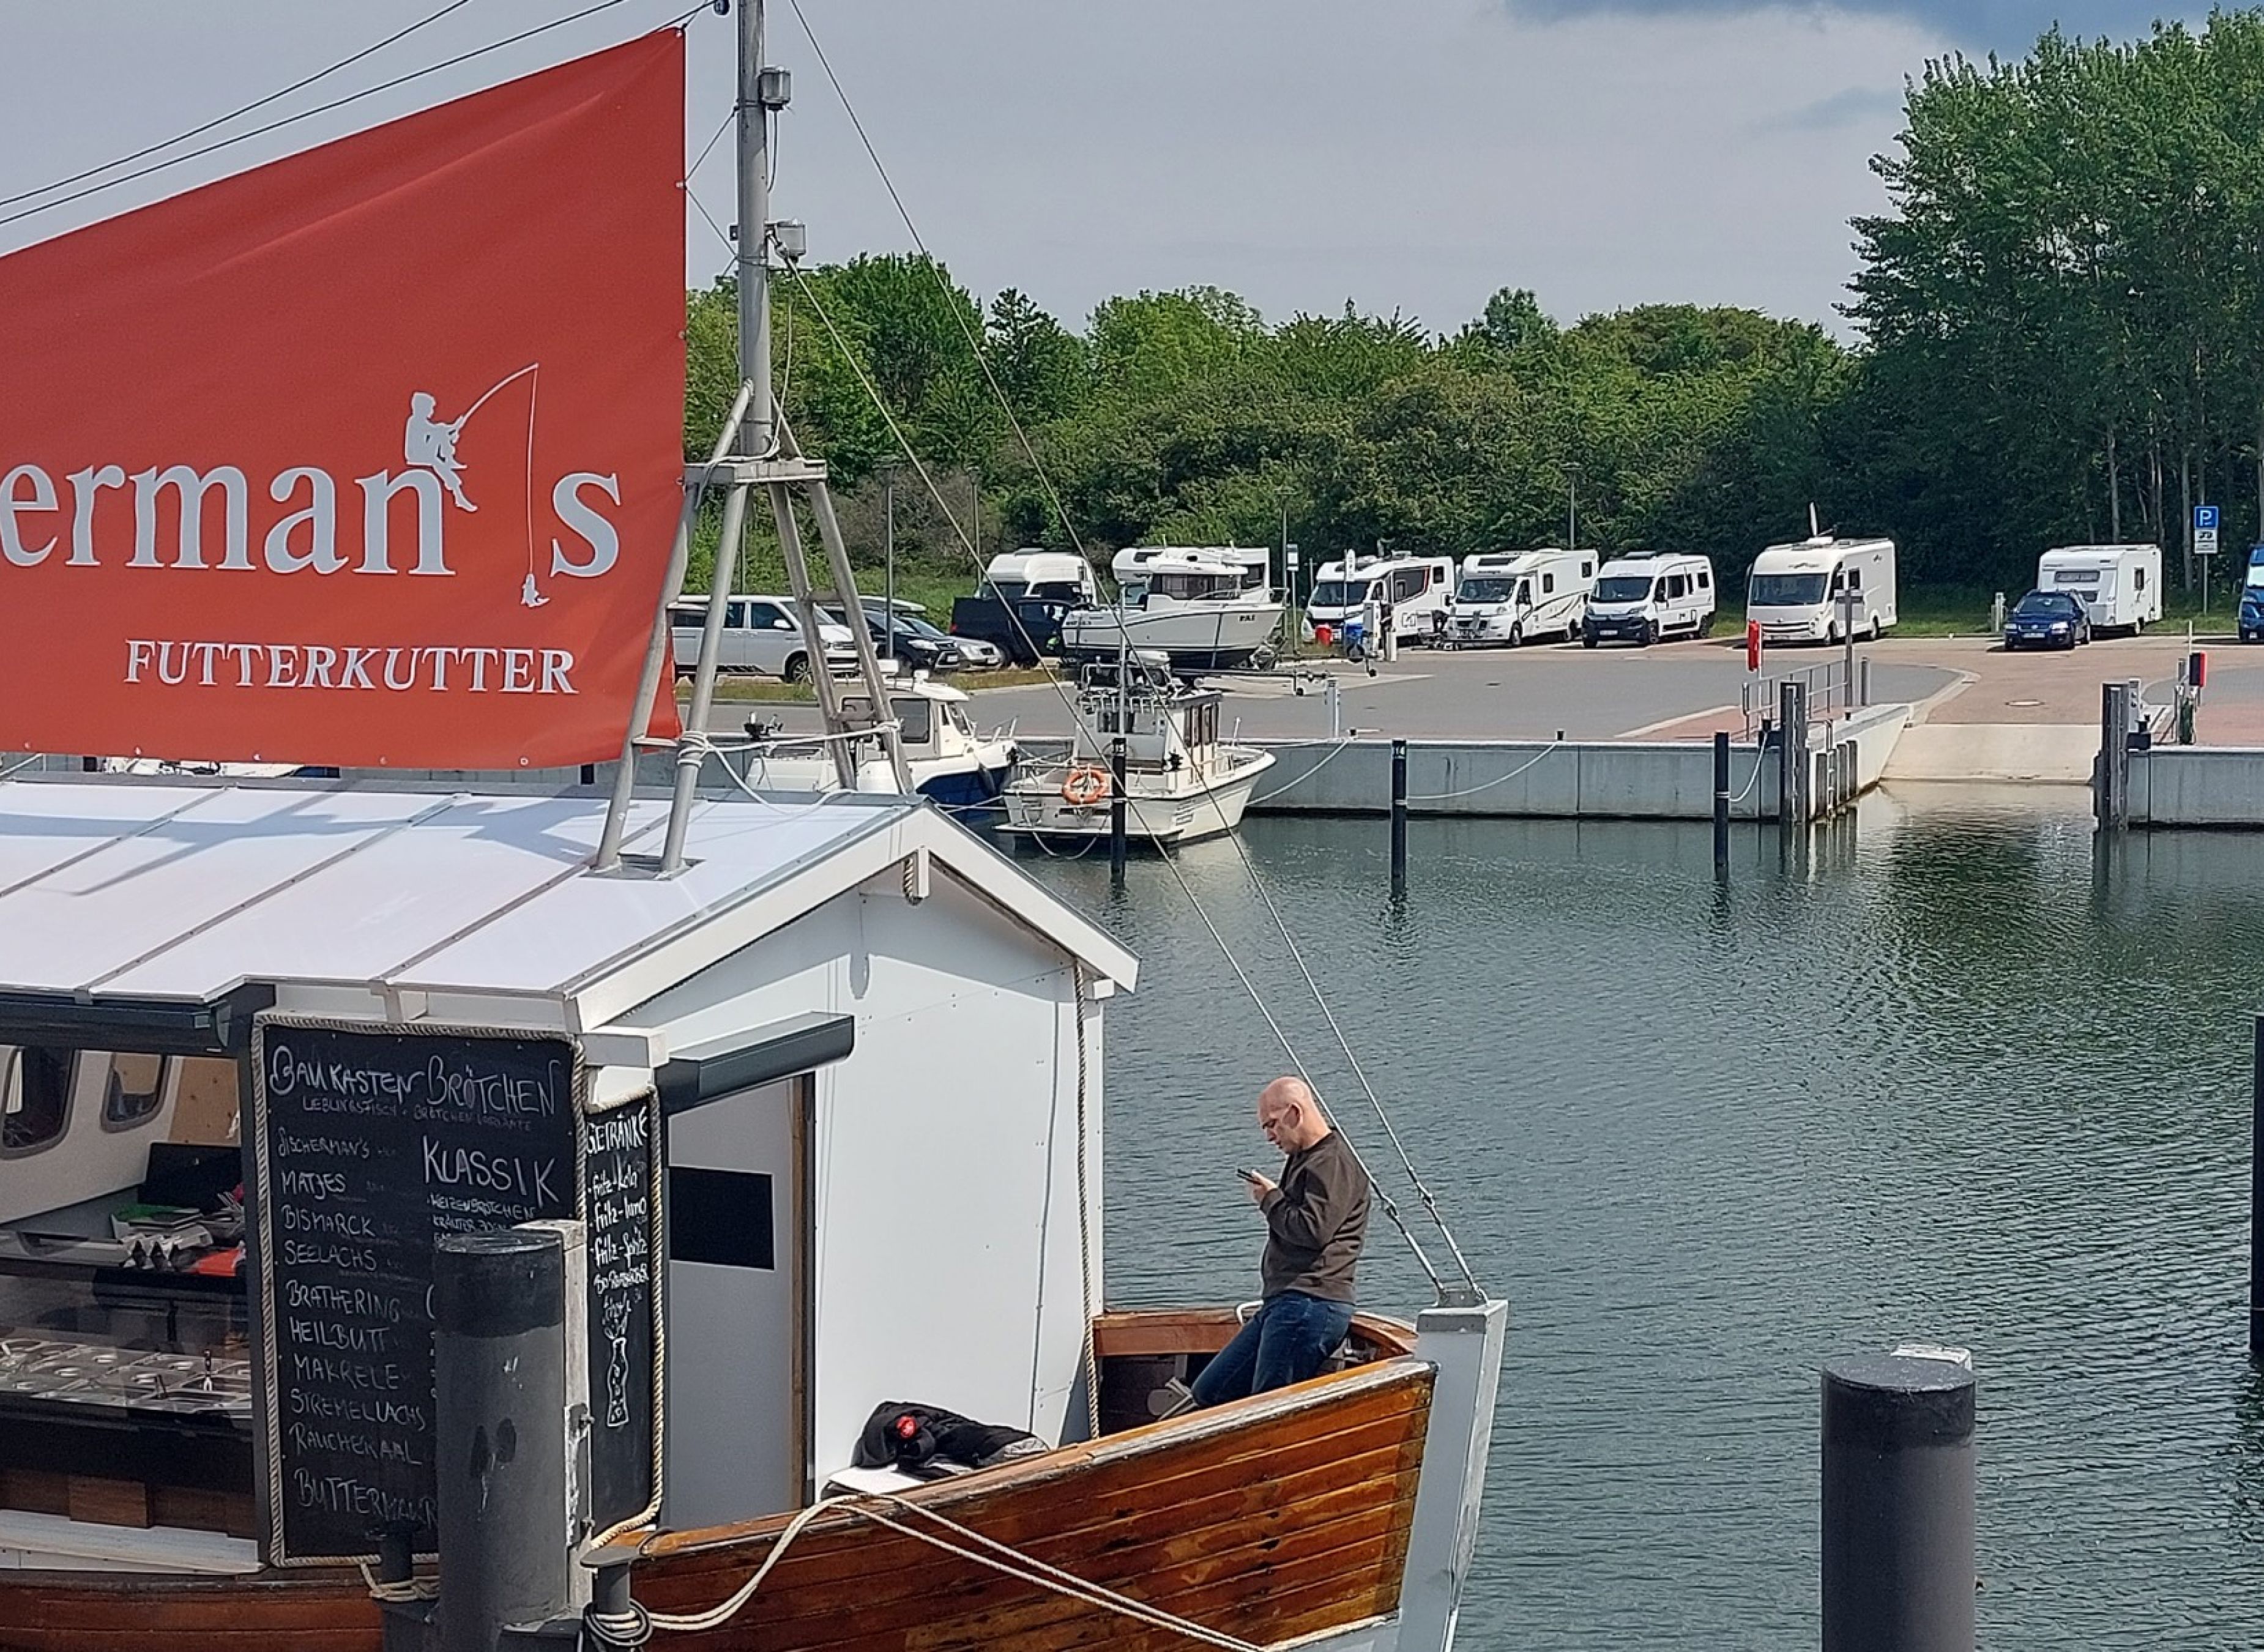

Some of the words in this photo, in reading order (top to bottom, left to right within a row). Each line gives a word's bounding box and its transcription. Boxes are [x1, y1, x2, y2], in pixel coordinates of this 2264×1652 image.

[2200, 509, 2212, 526] P
[124, 638, 579, 696] FUTTERKUTTER
[426, 1054, 562, 1116] BRÖTCHEN
[280, 1169, 347, 1200] MATJES
[422, 1134, 560, 1210] KLASSIK
[281, 1204, 376, 1238] BISMARCK
[284, 1239, 378, 1272] SEELACHS
[285, 1279, 401, 1323] BRATHERING
[288, 1315, 390, 1353] HEILBUTT
[293, 1352, 400, 1390] MAKRELE
